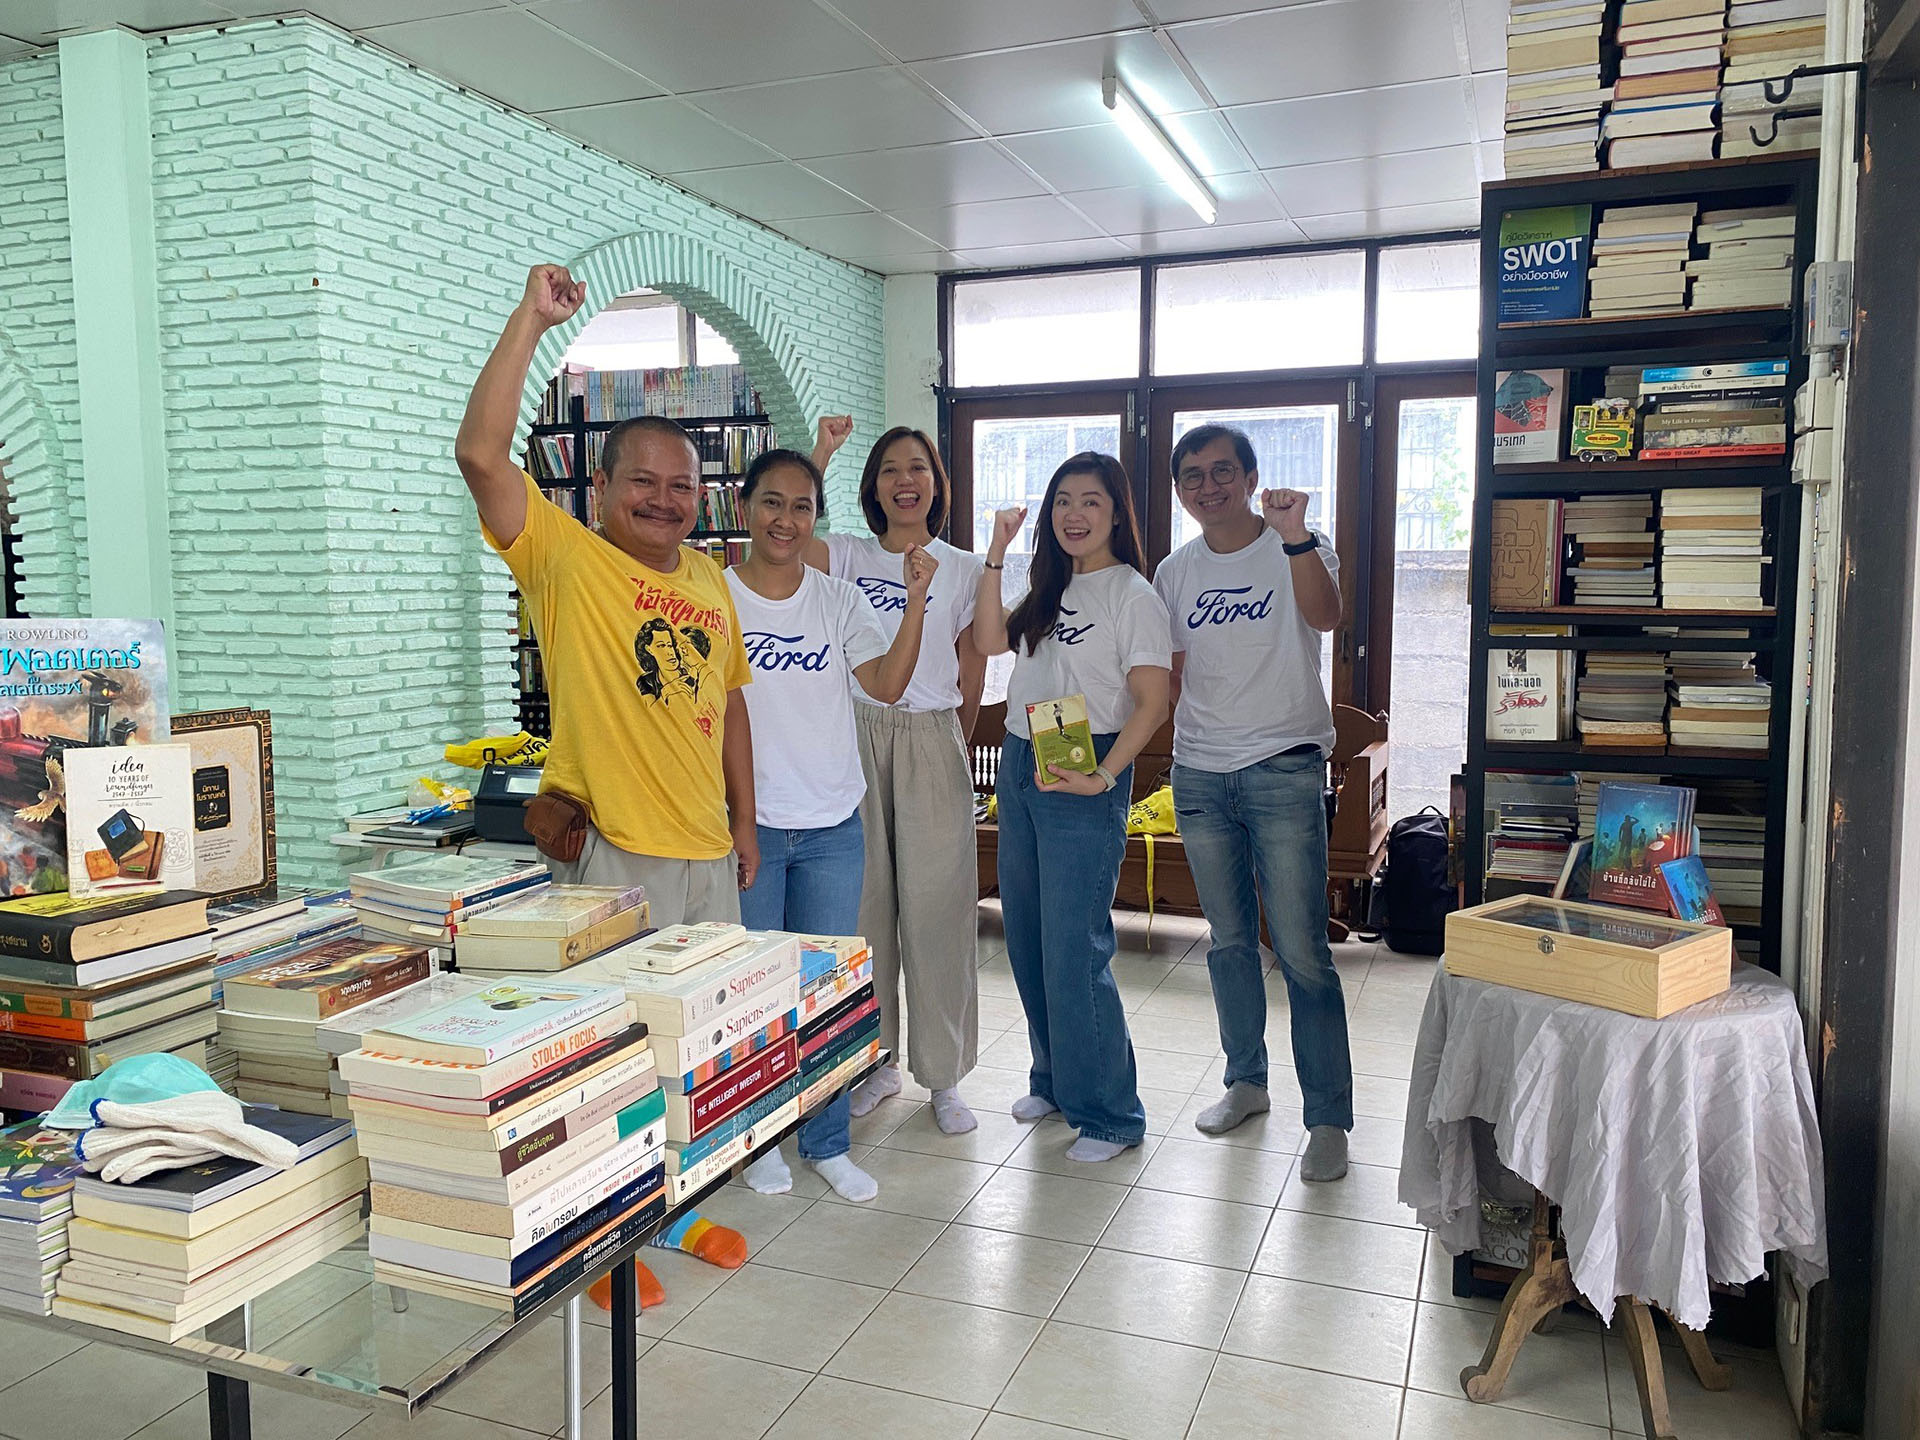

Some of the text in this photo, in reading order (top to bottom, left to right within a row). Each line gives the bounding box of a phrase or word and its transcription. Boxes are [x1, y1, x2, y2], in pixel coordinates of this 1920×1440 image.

[1503, 236, 1583, 271] SWOT
[1502, 269, 1569, 282] อย่างมืออาชีพ
[856, 576, 933, 615] For
[1187, 585, 1274, 630] Ford
[7, 628, 88, 641] ROWLING
[1048, 605, 1095, 646] rd
[742, 631, 831, 672] Ford
[112, 755, 144, 774] idea
[119, 775, 140, 783] YEARS
[141, 774, 149, 782] OF
[729, 967, 767, 998] Sapiens
[726, 1005, 764, 1038] Sapiens
[531, 1025, 598, 1069] STOLEN FOCUS
[696, 1069, 762, 1118] THE INTELLIGENT INVESTOR
[705, 1167, 715, 1177] the
[721, 1149, 741, 1165] Century
[711, 1147, 729, 1163] Lessons
[729, 1141, 737, 1151] for
[602, 1164, 643, 1196] INSIDE THE BOX
[531, 1205, 578, 1244] คิดในกรอบ
[1475, 1244, 1529, 1264] AGON
